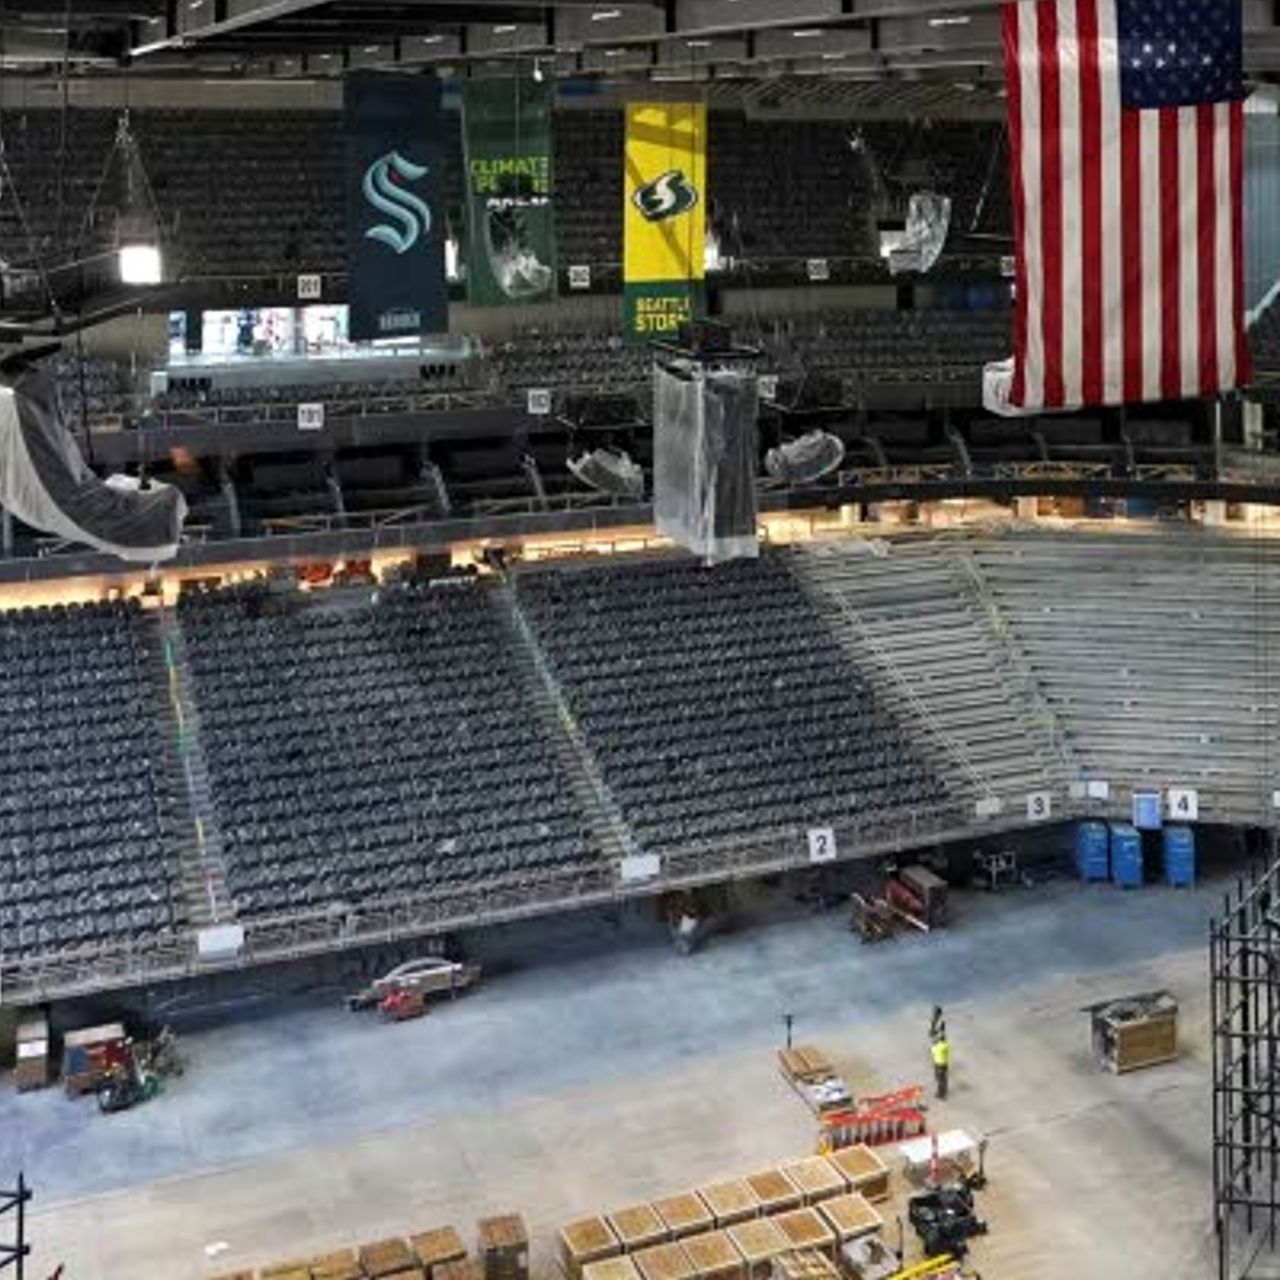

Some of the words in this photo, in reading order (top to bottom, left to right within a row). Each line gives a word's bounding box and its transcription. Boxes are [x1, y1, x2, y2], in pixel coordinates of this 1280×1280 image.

[470, 156, 549, 176] CLIMATE
[1033, 796, 1045, 817] 3
[1177, 793, 1189, 814] 4
[816, 835, 827, 856] 2
